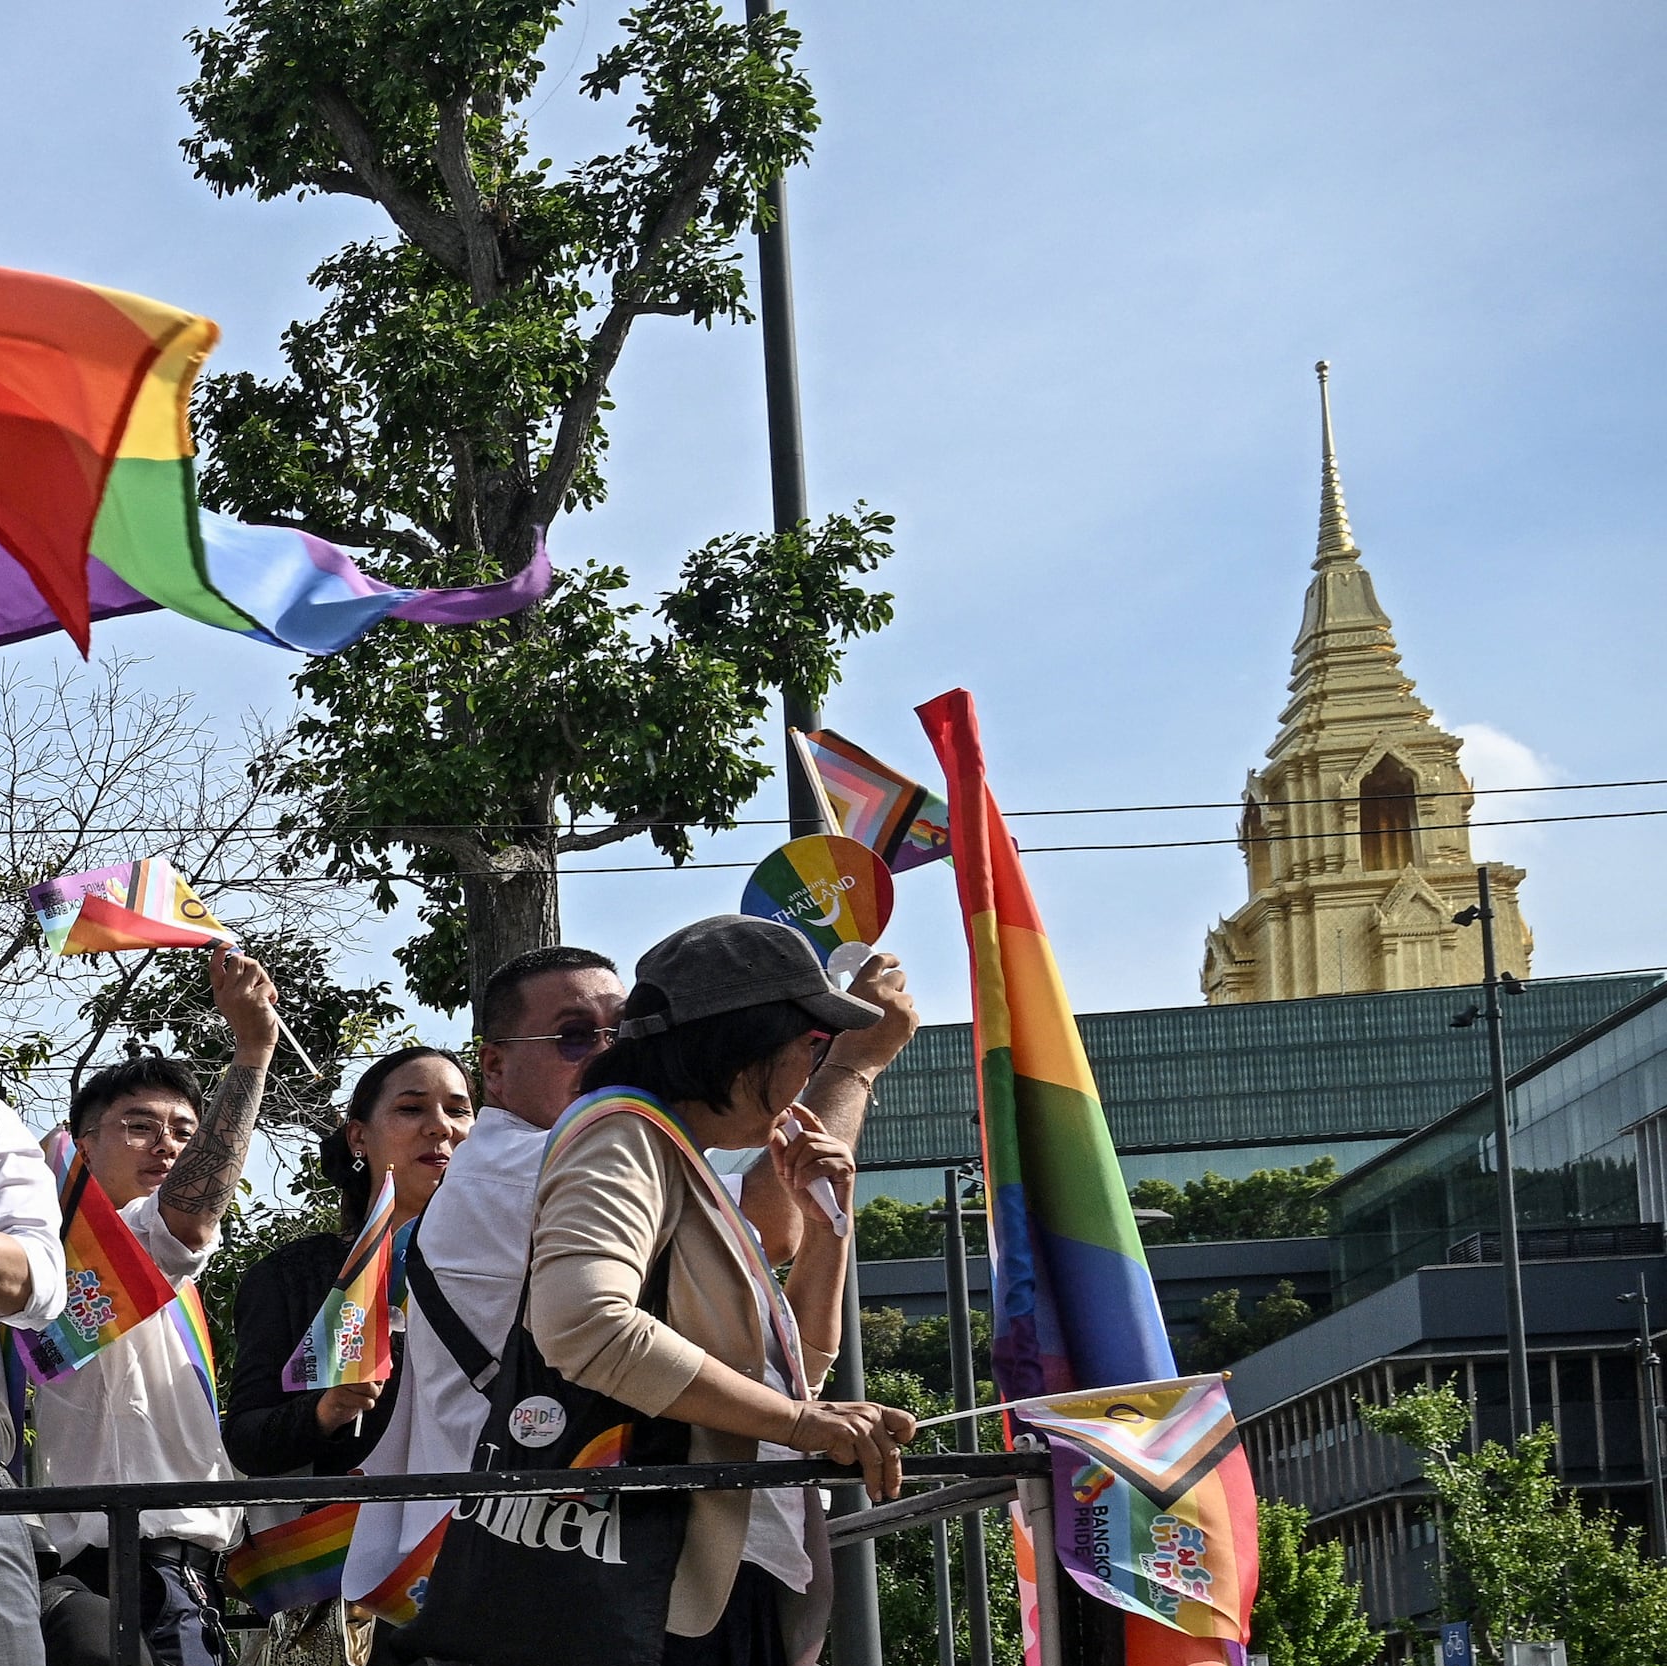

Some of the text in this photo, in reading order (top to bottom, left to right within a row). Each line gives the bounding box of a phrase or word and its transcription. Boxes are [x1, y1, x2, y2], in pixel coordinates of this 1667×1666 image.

[771, 875, 856, 924] THAILAND
[513, 1407, 565, 1426] PRIDE!
[1075, 1507, 1091, 1557] PRIDE
[1092, 1505, 1112, 1581] BANGKO
